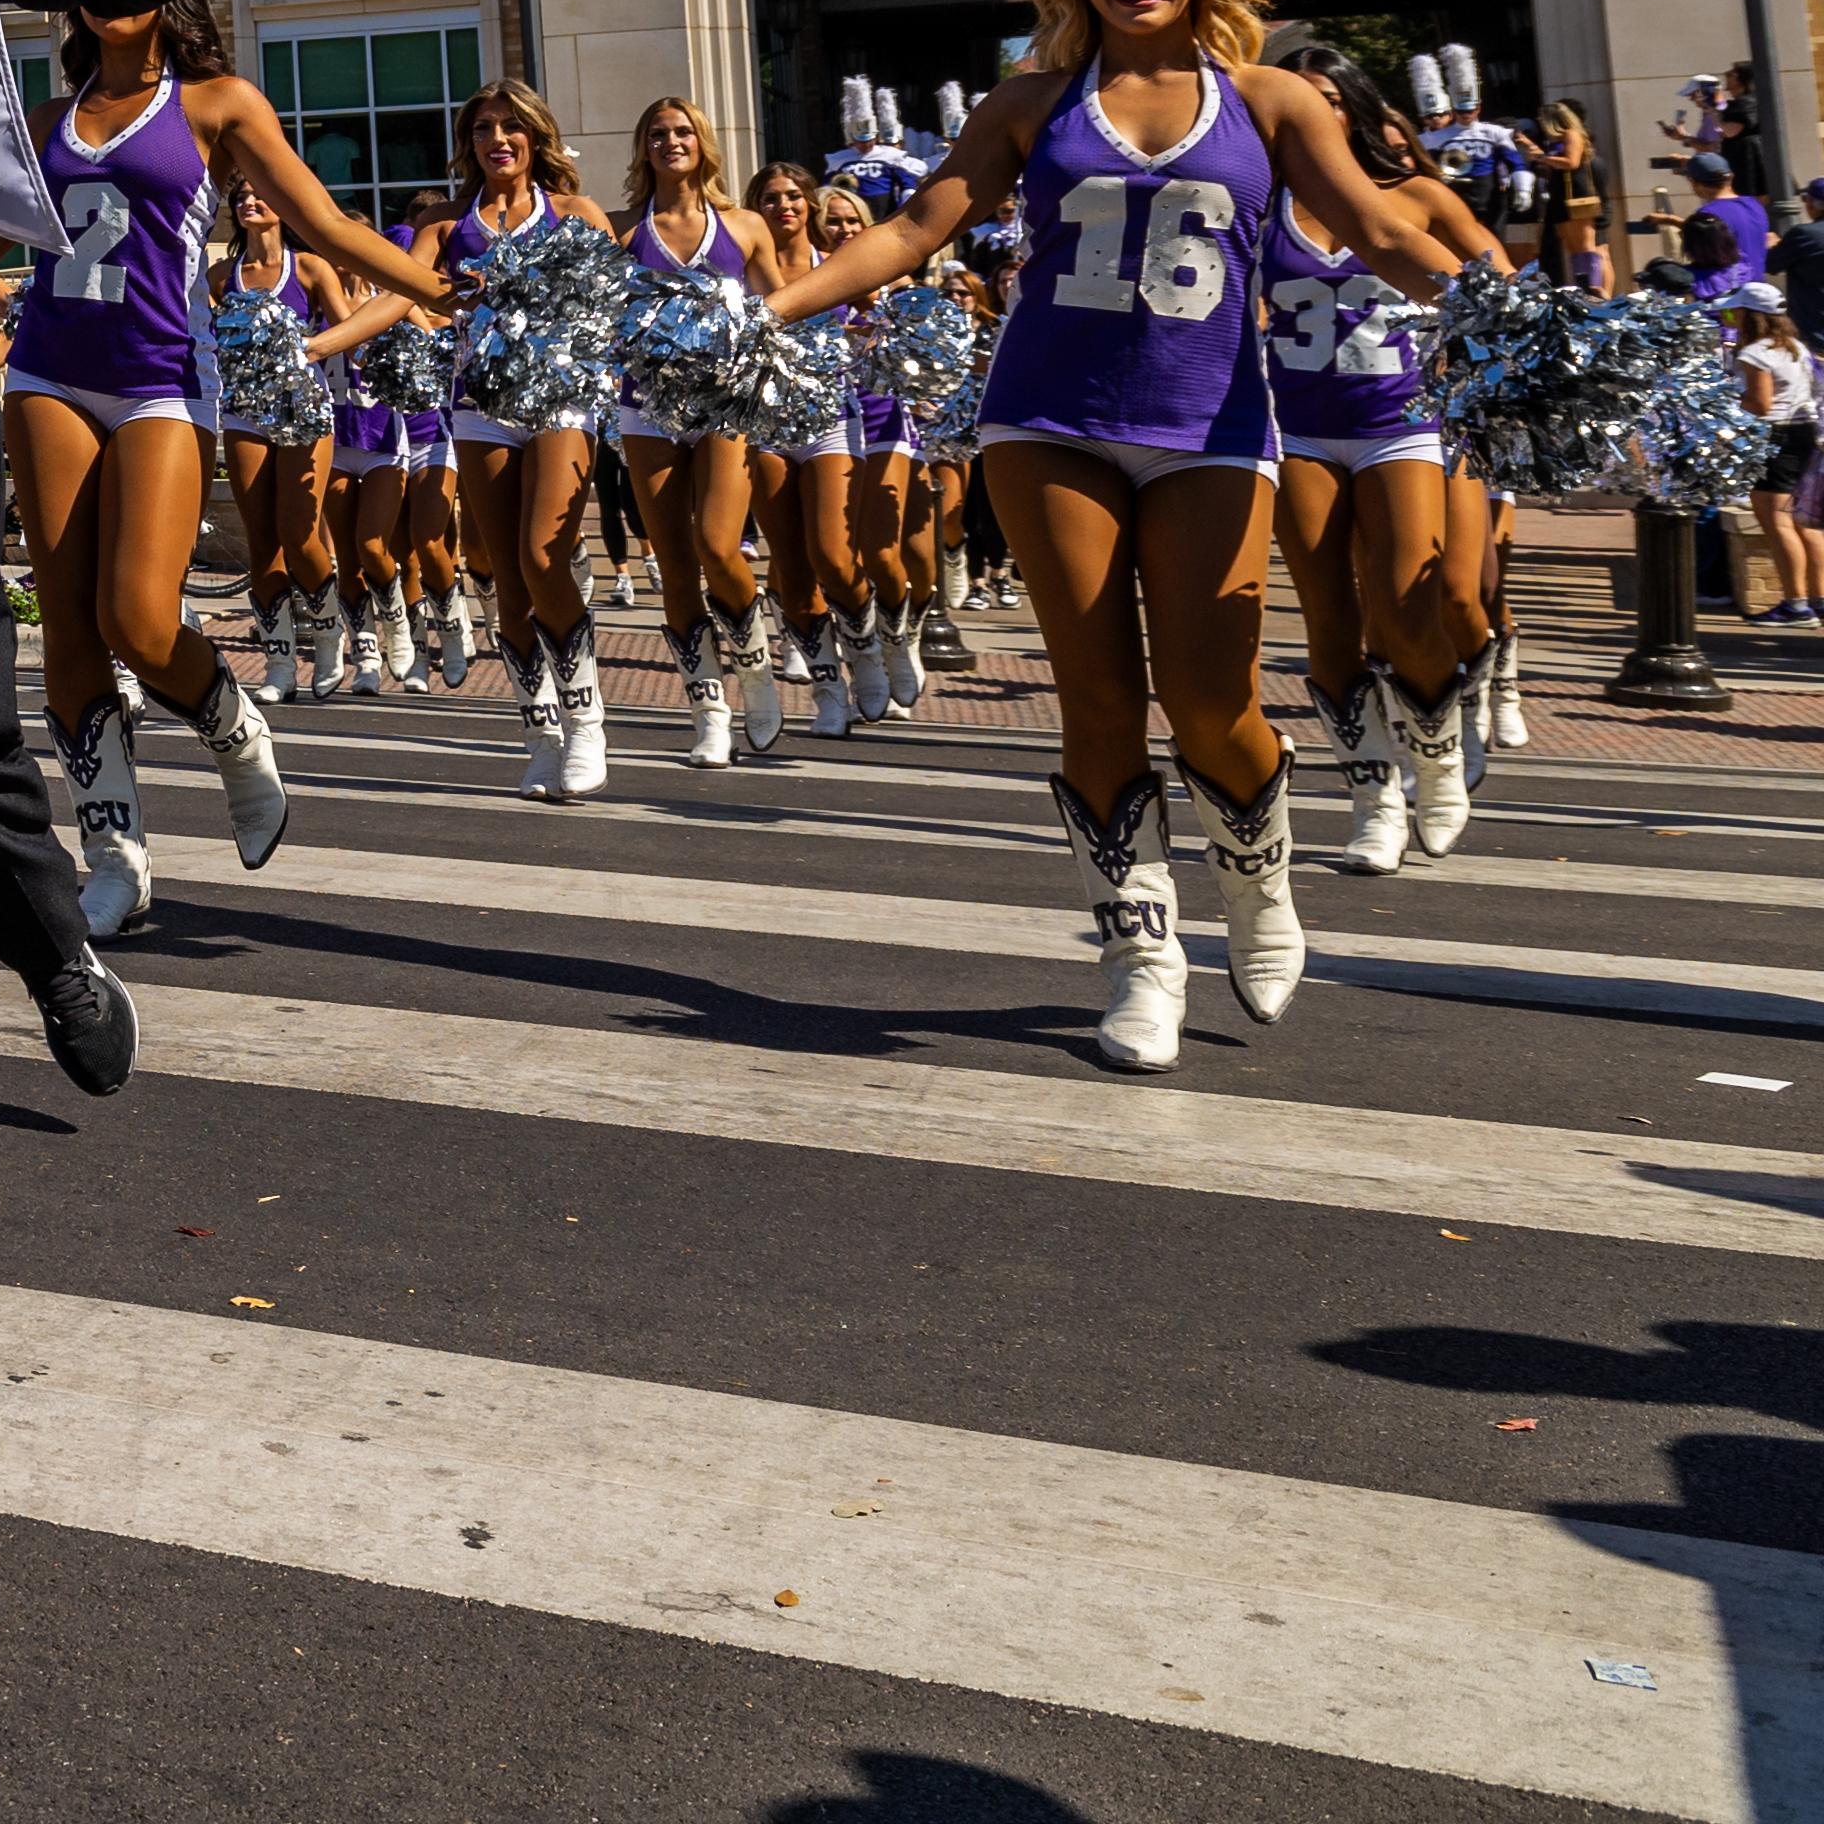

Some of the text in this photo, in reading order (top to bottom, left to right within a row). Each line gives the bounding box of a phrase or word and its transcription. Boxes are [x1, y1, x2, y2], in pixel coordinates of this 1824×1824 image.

[52, 182, 130, 304] 2
[1052, 176, 1236, 322] 16
[1270, 274, 1405, 375] 32
[311, 616, 337, 632] CU
[263, 638, 291, 656] CU
[811, 663, 840, 683] CU
[559, 685, 593, 711] CU
[90, 707, 106, 728] TCU
[1129, 792, 1146, 813] TCU
[1214, 837, 1286, 876] TCU
[1092, 900, 1168, 943] TCU
